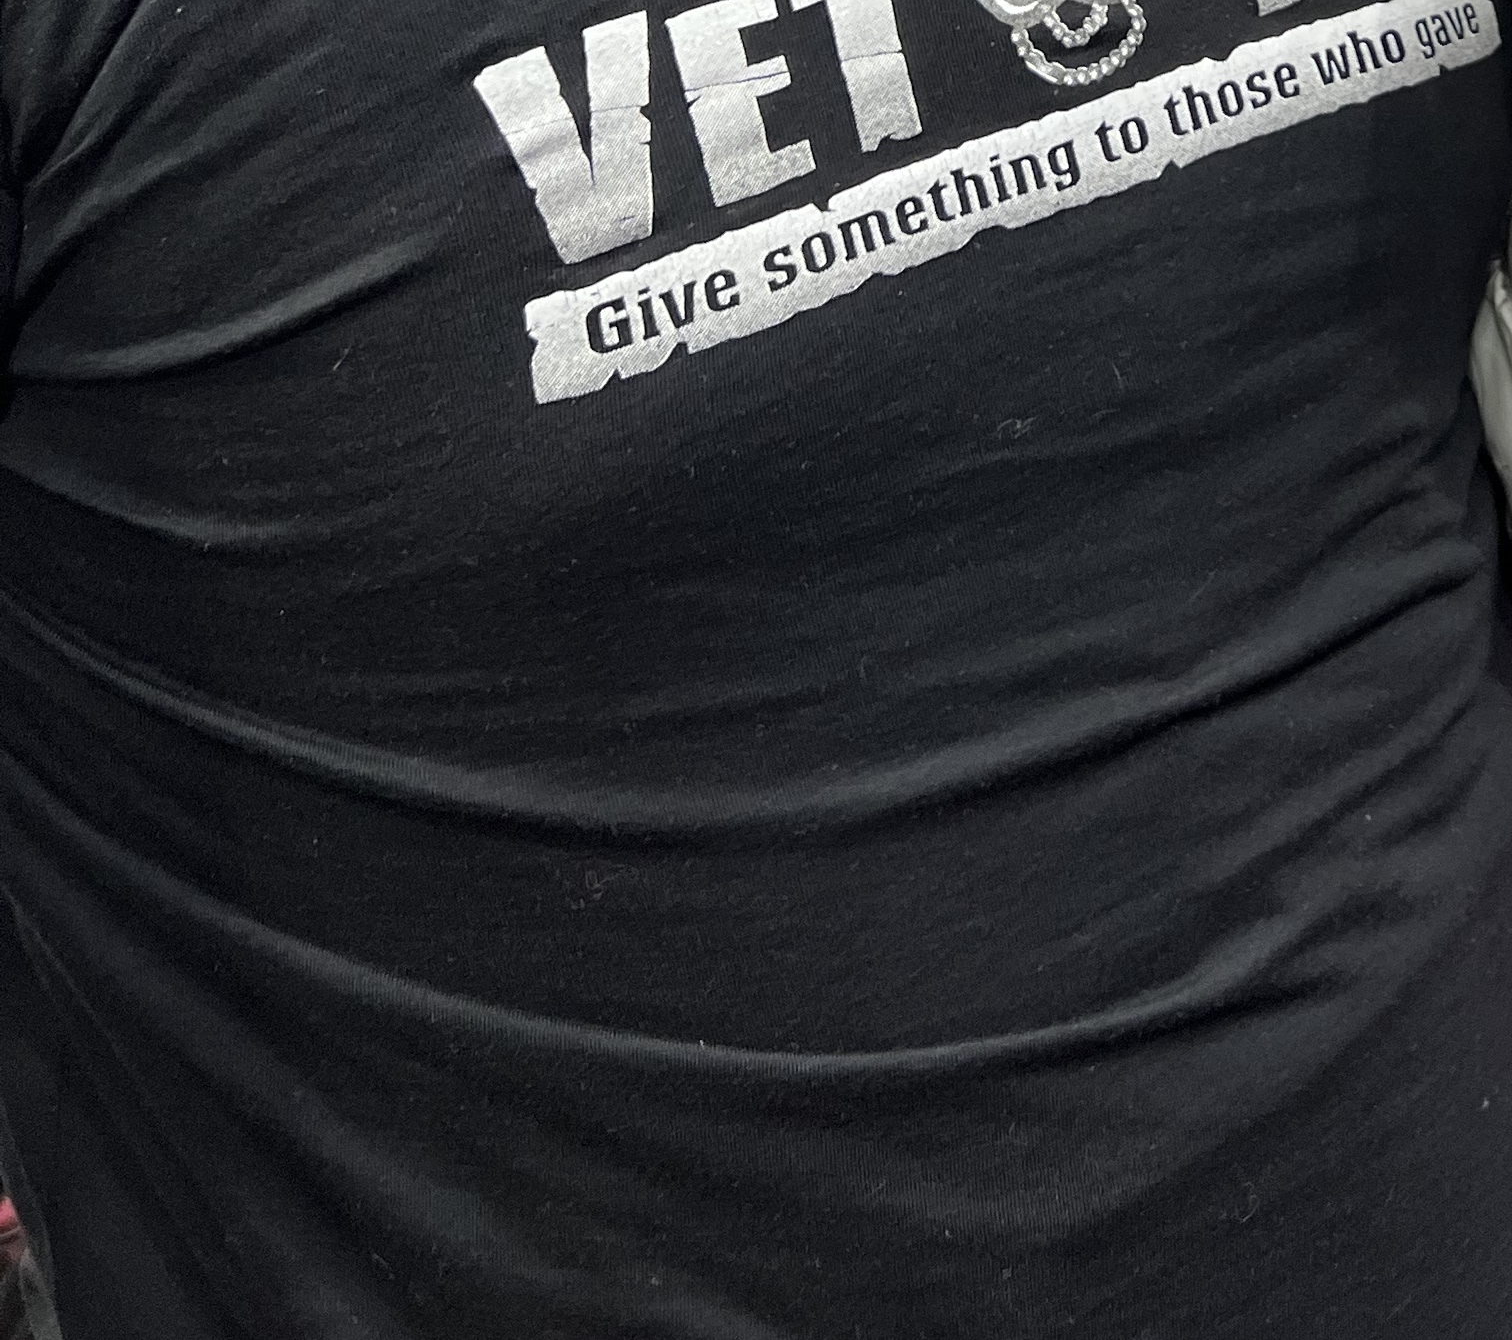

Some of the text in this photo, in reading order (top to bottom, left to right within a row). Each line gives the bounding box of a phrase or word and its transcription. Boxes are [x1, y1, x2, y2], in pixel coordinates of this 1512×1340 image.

[585, 1, 1481, 354] Give something to those who gave
